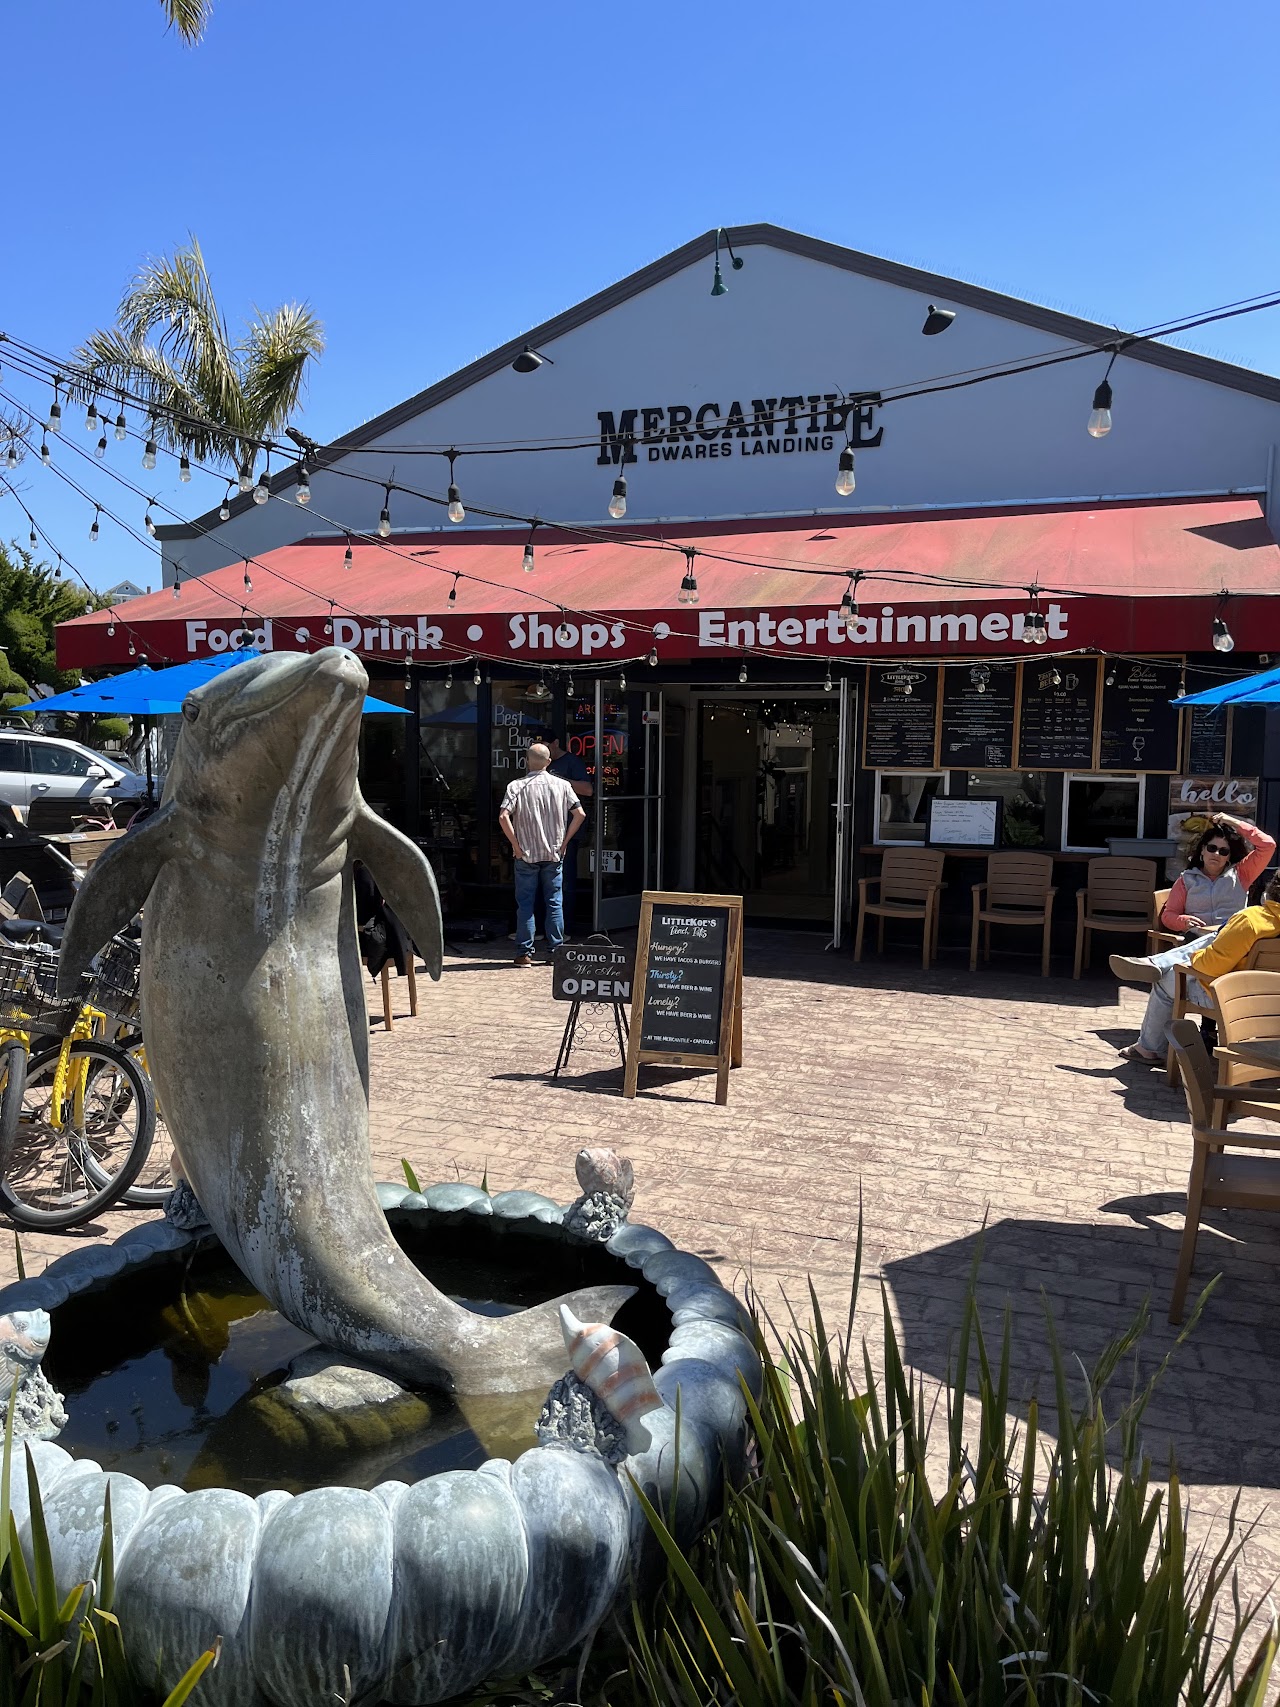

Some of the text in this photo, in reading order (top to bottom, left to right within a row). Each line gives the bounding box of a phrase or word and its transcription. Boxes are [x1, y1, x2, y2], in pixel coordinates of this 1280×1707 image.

[597, 391, 884, 465] MERCANTILE
[741, 435, 834, 456] LANDING
[185, 617, 274, 653] Food
[332, 617, 443, 651] Drink
[507, 613, 627, 655] Shops
[494, 704, 526, 727] Best
[492, 749, 510, 769] In
[1180, 779, 1256, 805] hello
[661, 916, 717, 927] LITTLEKOE'S
[565, 950, 626, 964] Come In
[650, 941, 689, 956] Hungry?
[573, 963, 621, 977] We Are
[649, 969, 684, 984] Thirsty?
[562, 978, 630, 997] OPEN
[647, 995, 681, 1010] Lonely?
[662, 1036, 690, 1044] MERCANTILE
